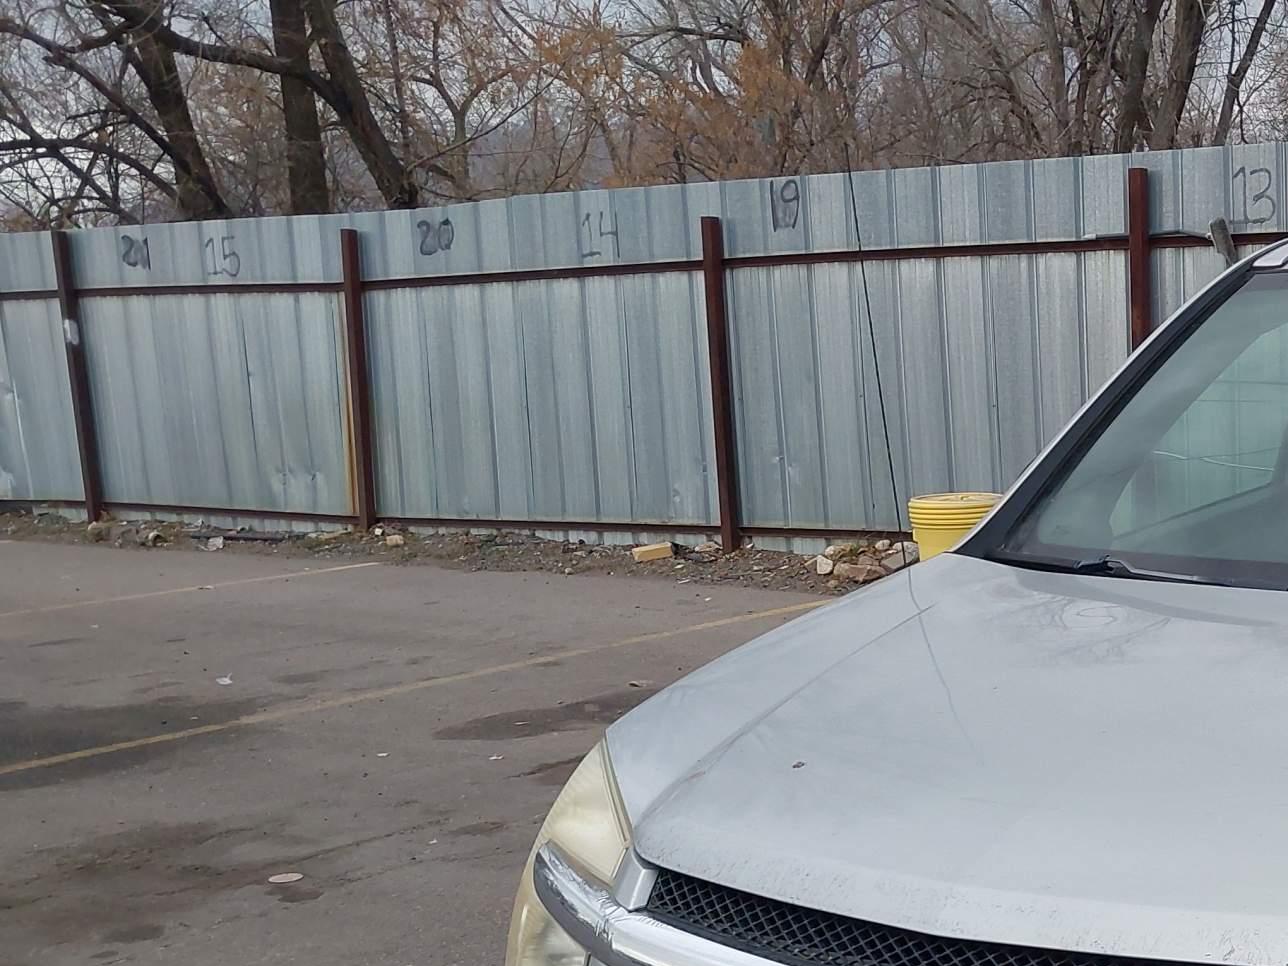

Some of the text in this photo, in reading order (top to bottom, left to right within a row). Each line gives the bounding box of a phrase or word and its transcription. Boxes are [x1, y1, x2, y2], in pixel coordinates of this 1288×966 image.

[769, 179, 800, 232] 19
[1230, 165, 1277, 224] 13
[205, 235, 240, 277] 15
[416, 218, 455, 256] 20
[581, 210, 620, 258] 14
